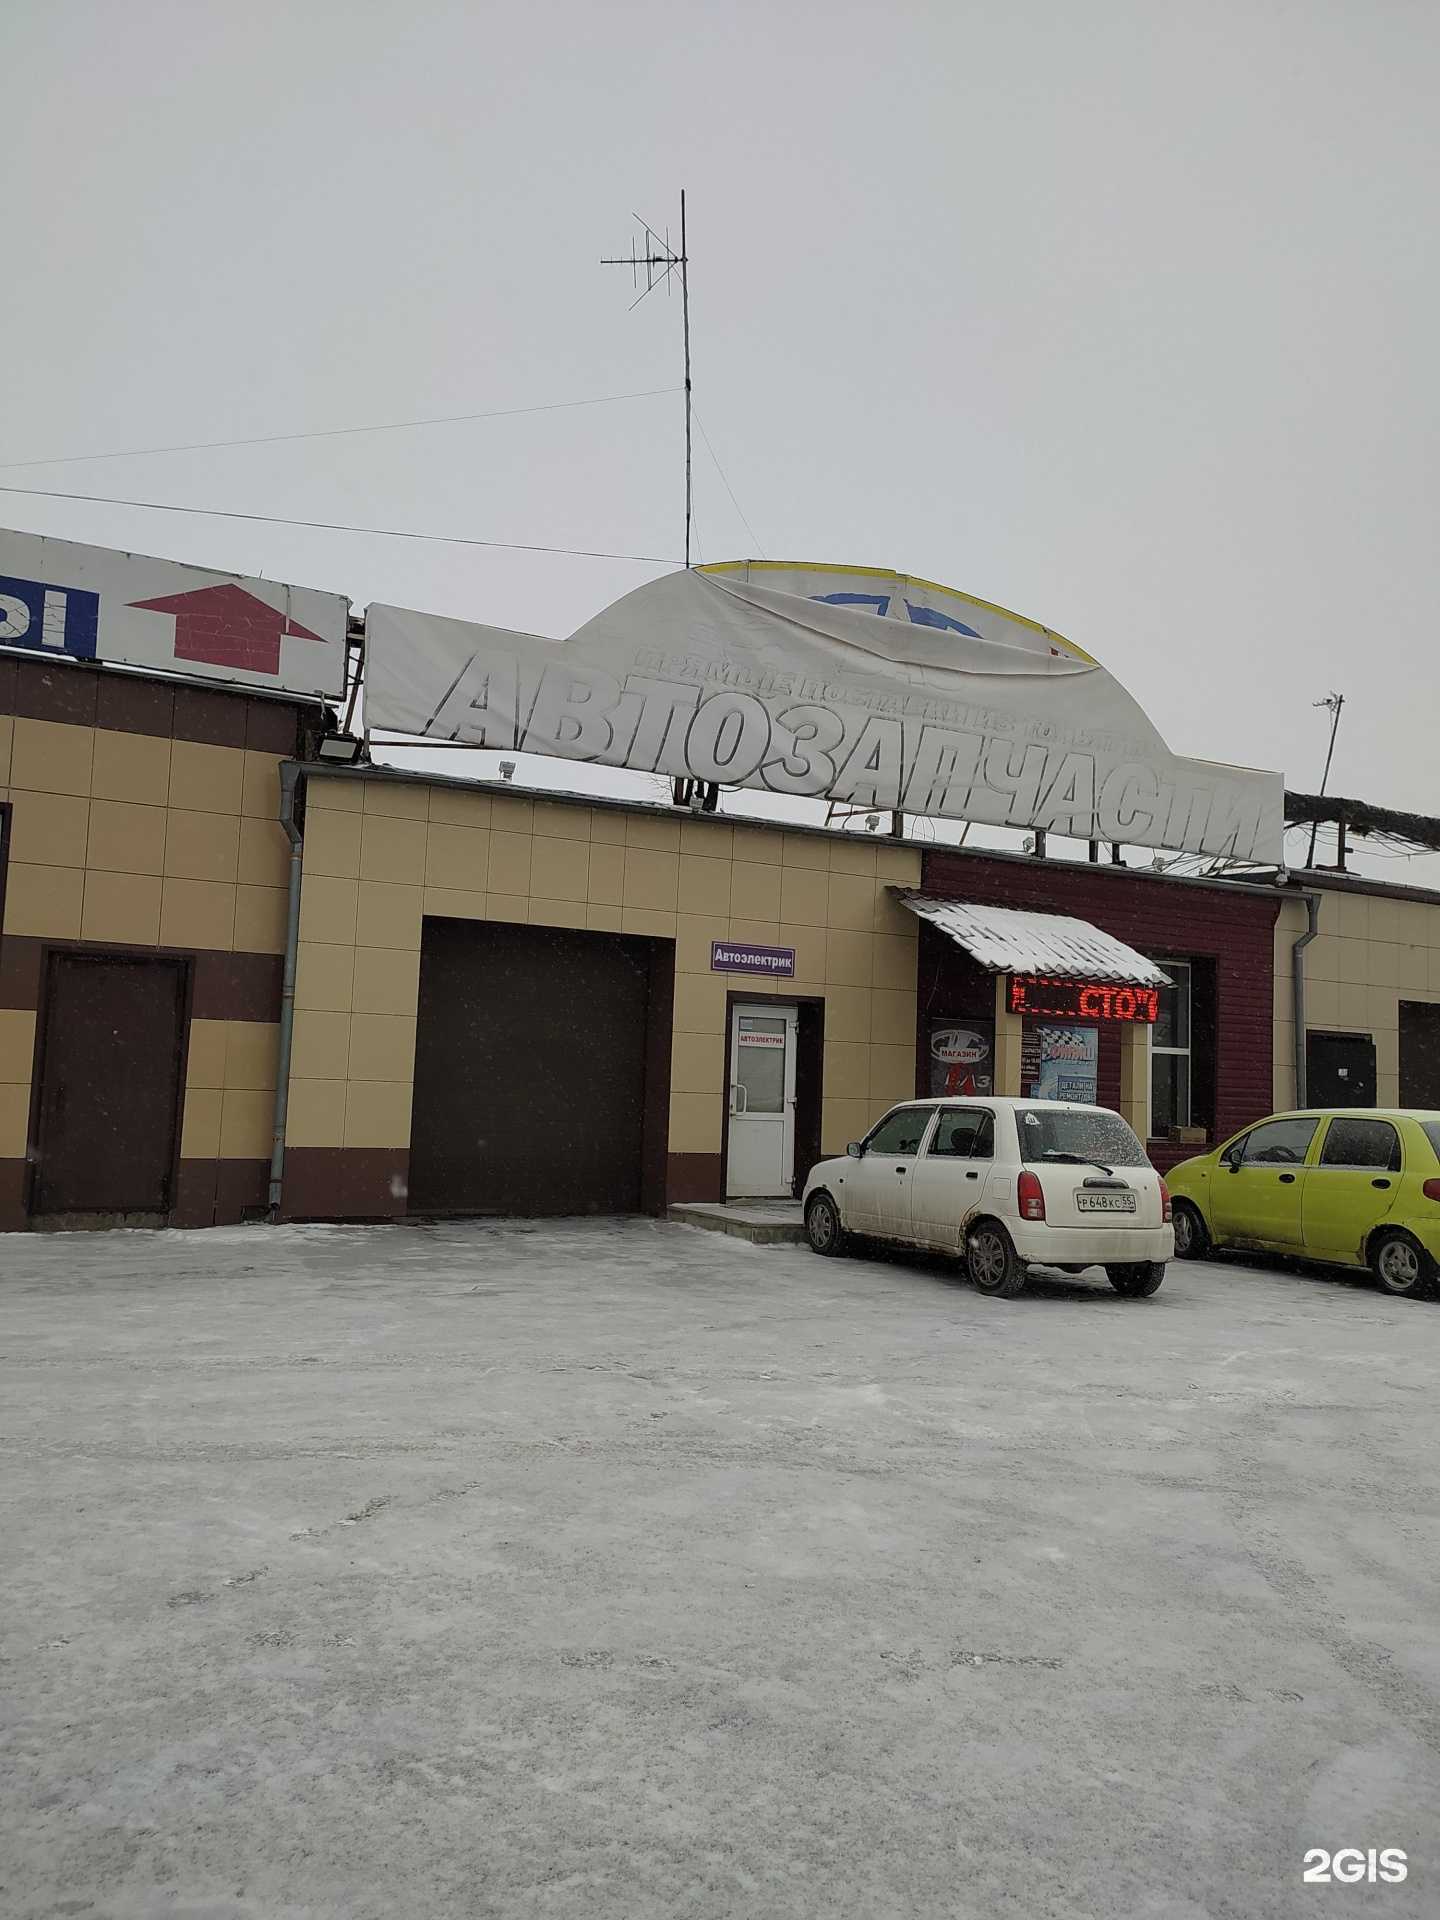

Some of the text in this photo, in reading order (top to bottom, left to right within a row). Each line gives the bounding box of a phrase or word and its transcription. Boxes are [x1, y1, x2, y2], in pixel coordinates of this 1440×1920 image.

[418, 648, 1268, 860] АВТОЗАПЧАСТИ
[714, 948, 792, 969] Автоэлектрик
[740, 1035, 784, 1045] АВТОЭЛЕКТРИК
[941, 1049, 977, 1058] МАГАЗИН
